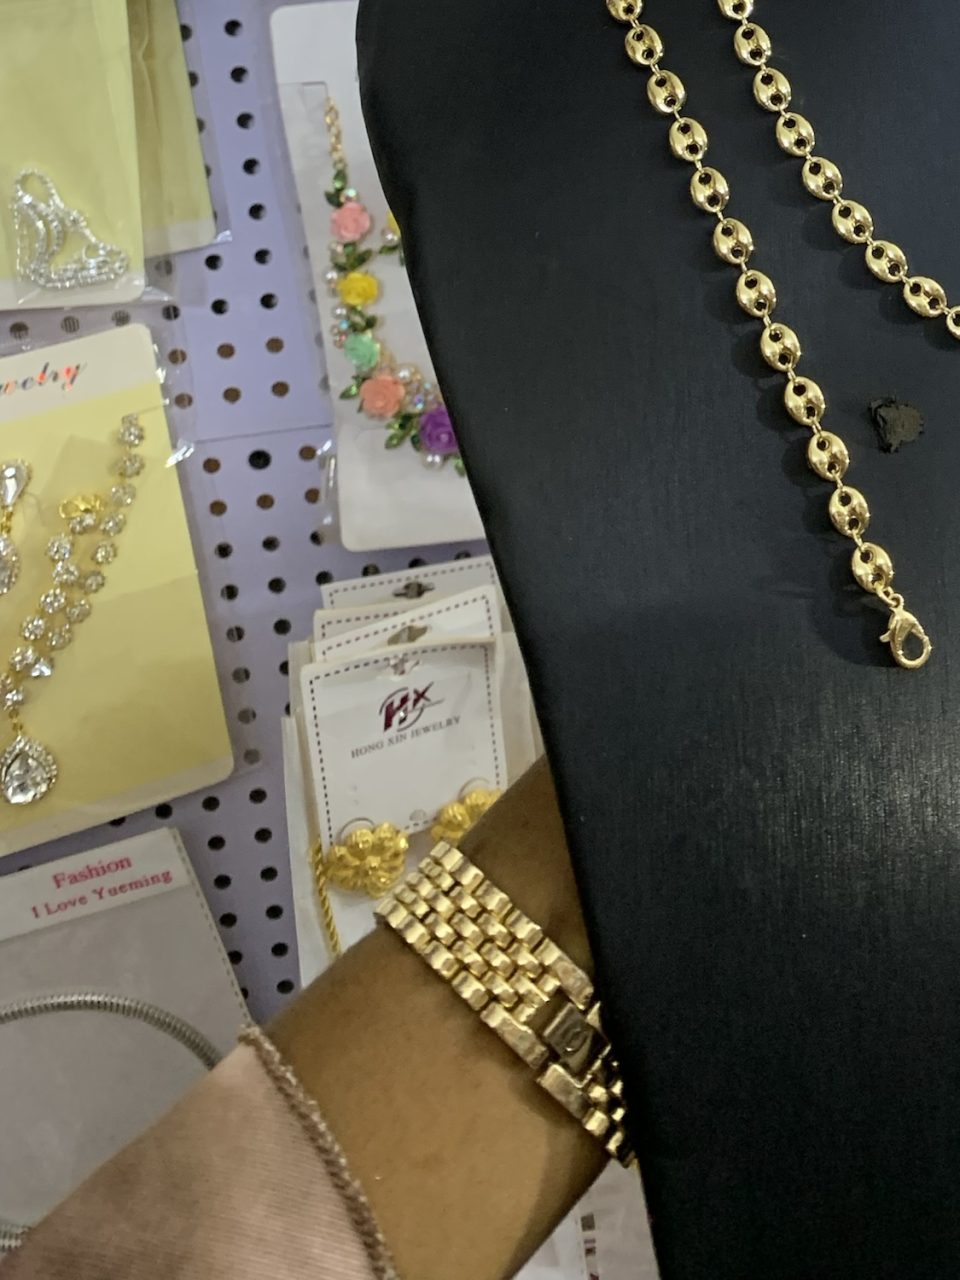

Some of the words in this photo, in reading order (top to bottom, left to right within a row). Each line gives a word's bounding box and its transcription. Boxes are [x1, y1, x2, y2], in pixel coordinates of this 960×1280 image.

[351, 741, 384, 759] HONG
[387, 733, 408, 747] XIN
[52, 855, 132, 889] Fashion
[45, 894, 89, 916] Love
[91, 871, 173, 901] Yueming
